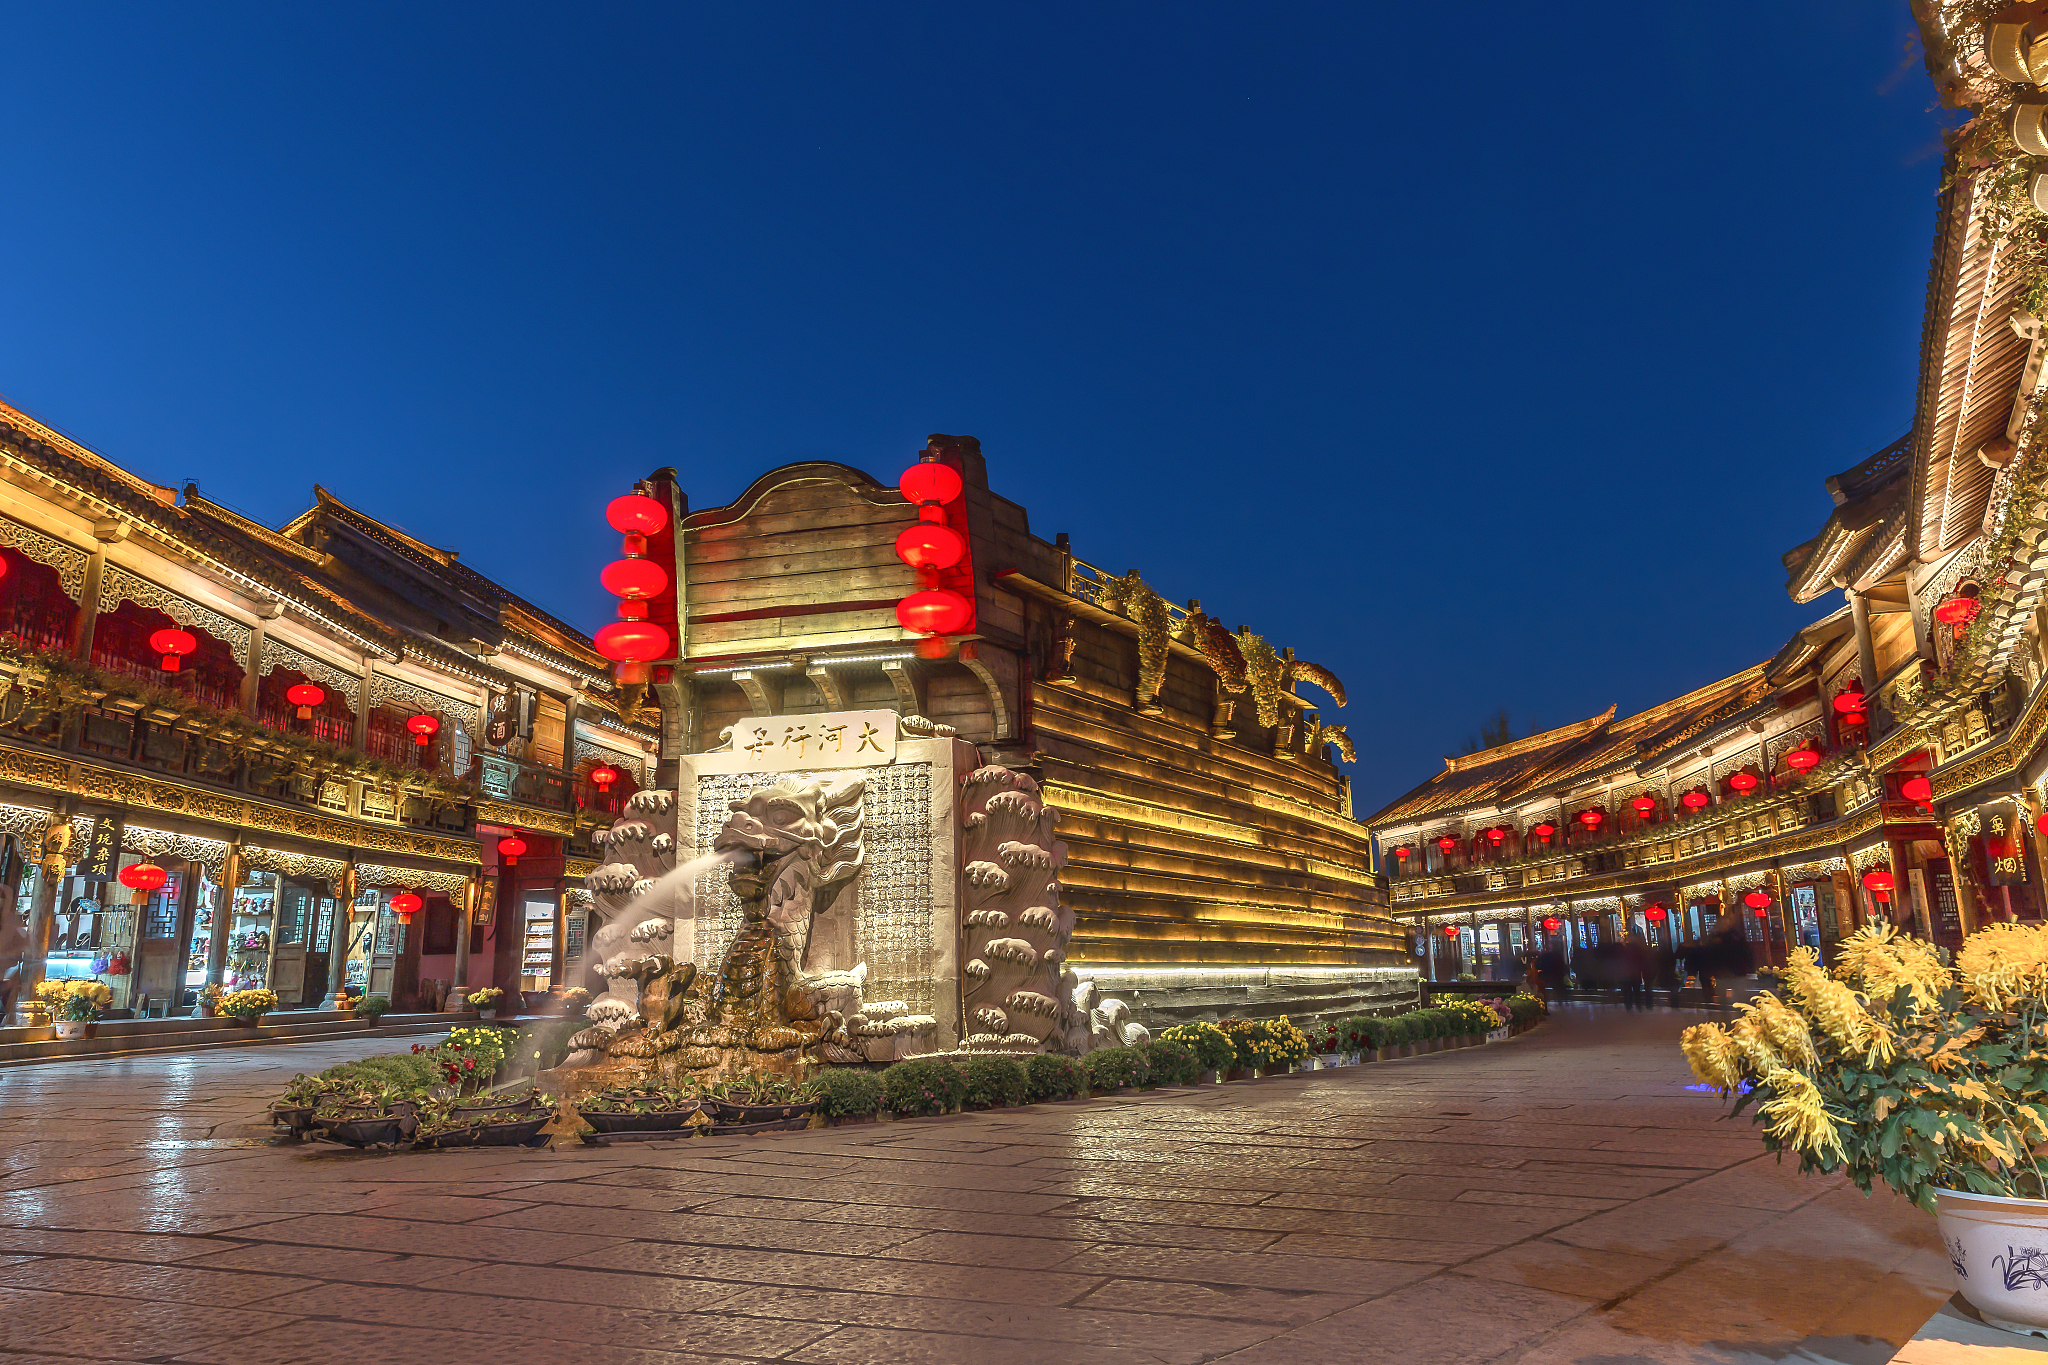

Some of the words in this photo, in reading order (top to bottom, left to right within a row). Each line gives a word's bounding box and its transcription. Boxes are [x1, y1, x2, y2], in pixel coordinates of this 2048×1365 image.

[743, 721, 885, 761] 大河行舟
[91, 817, 115, 876] 文玩杂项
